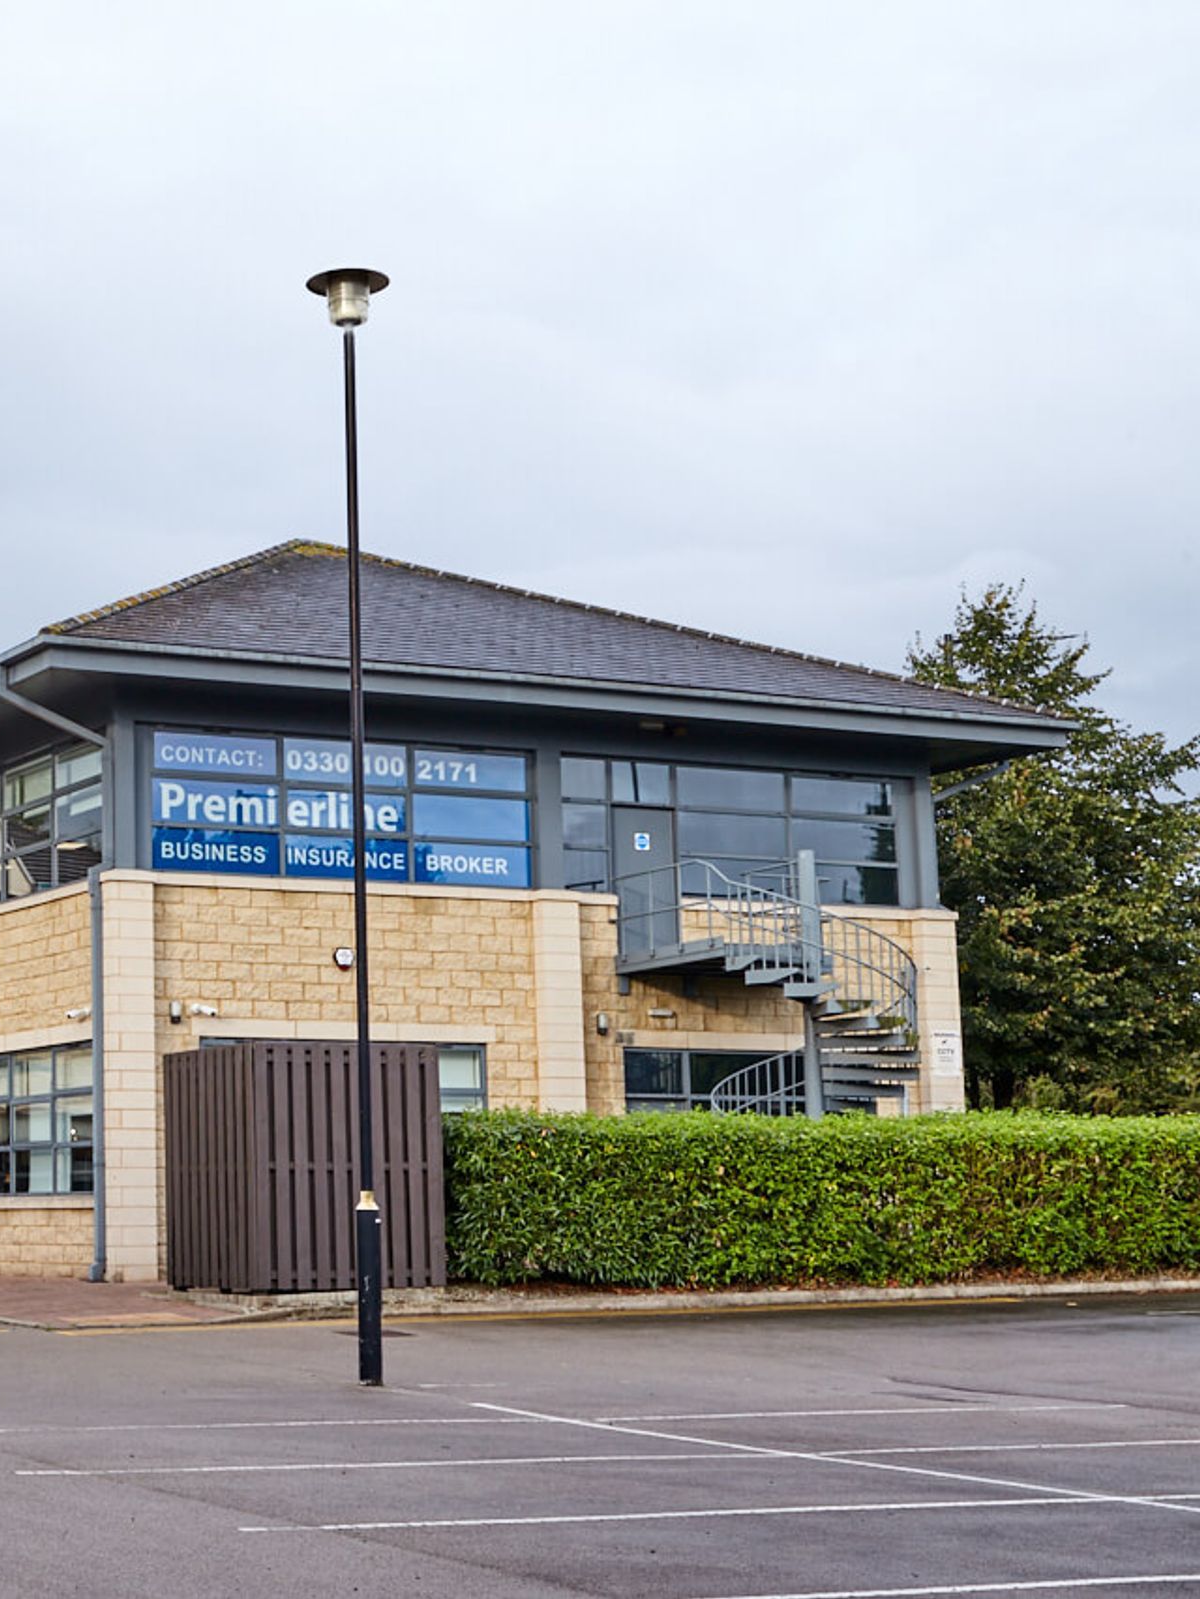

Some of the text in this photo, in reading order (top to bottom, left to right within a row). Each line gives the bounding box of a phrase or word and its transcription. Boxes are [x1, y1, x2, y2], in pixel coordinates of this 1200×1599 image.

[161, 745, 477, 783] CONTACT: 0330 100 2171
[161, 841, 267, 864] BUSINESS
[426, 854, 509, 876] BROKER
